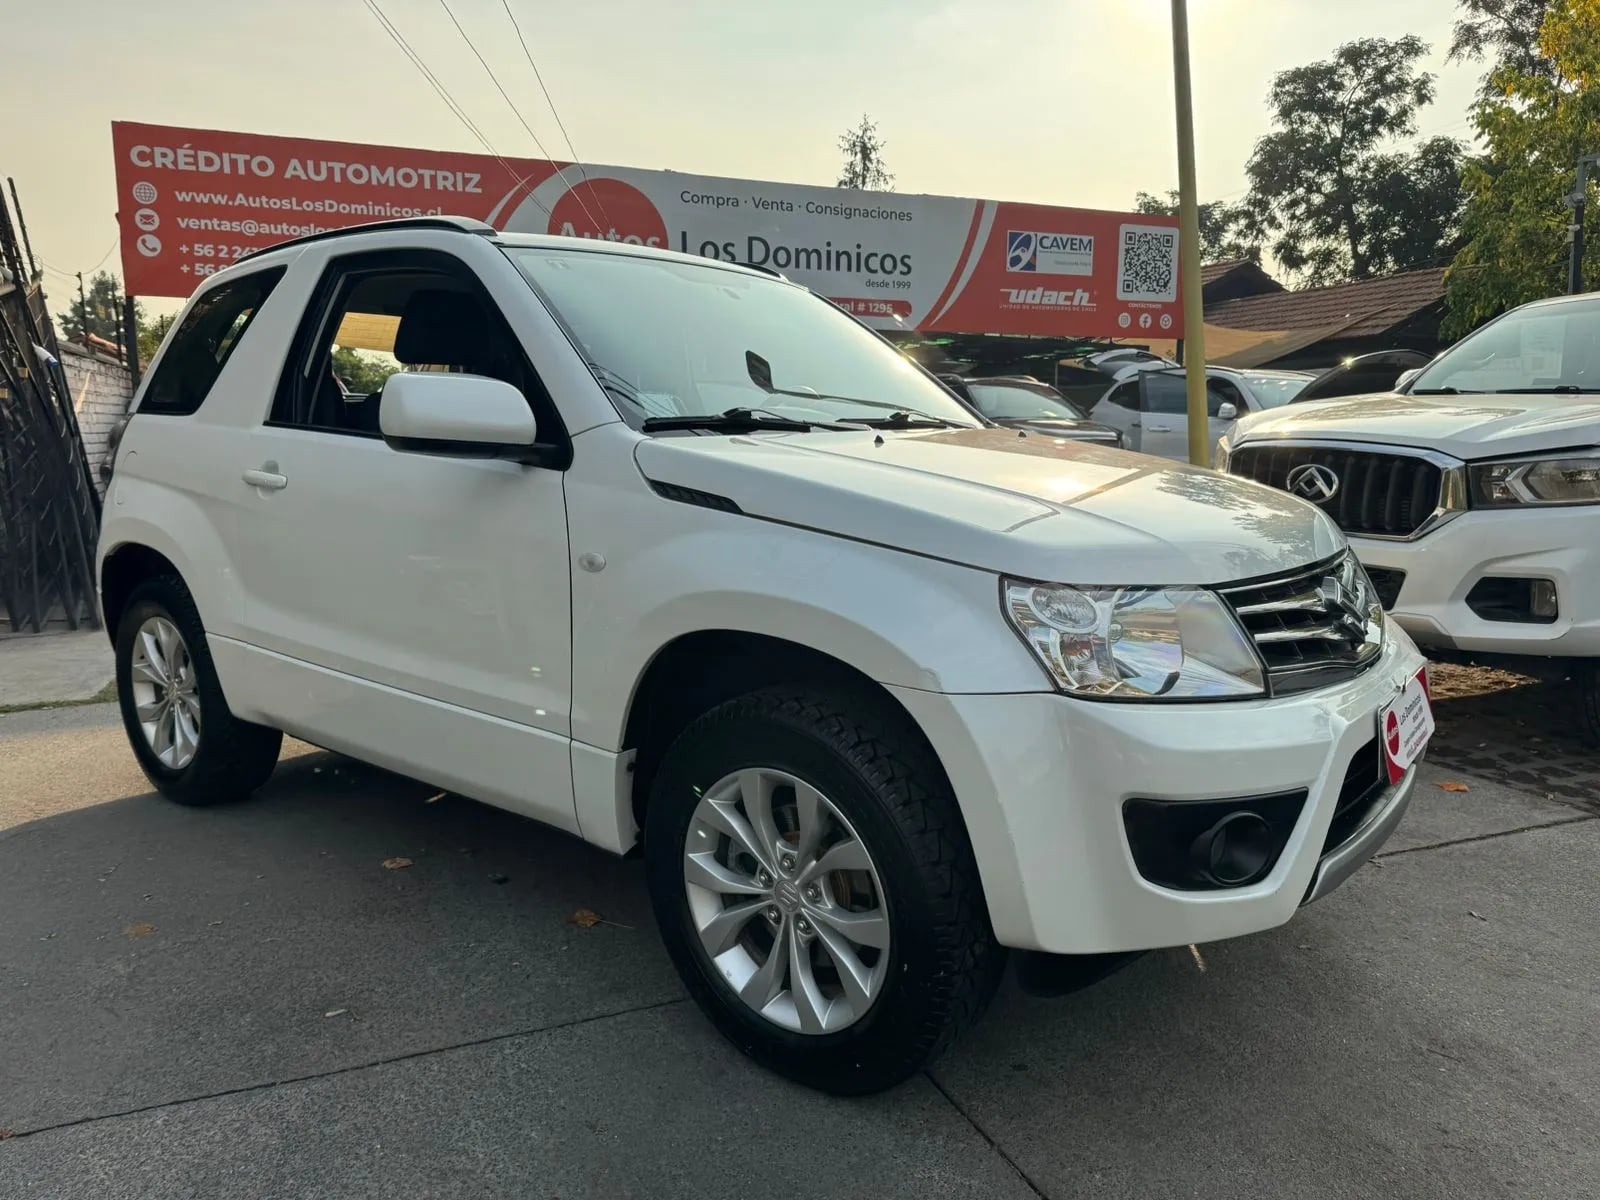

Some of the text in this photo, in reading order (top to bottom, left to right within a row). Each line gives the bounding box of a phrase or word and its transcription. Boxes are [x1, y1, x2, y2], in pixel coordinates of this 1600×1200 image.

[130, 143, 482, 194] CRÉDITO AUTOMOTRIZ
[175, 190, 442, 218] www.AutosLosDominicos.cl
[680, 190, 913, 222] Compra Venta Consignaciones
[193, 243, 215, 257] 56
[1039, 236, 1092, 252] CAVEM
[747, 236, 912, 276] Dominicos
[865, 279, 911, 289] desde 1999
[1000, 286, 1097, 306] udach
[868, 302, 893, 314] 1295
